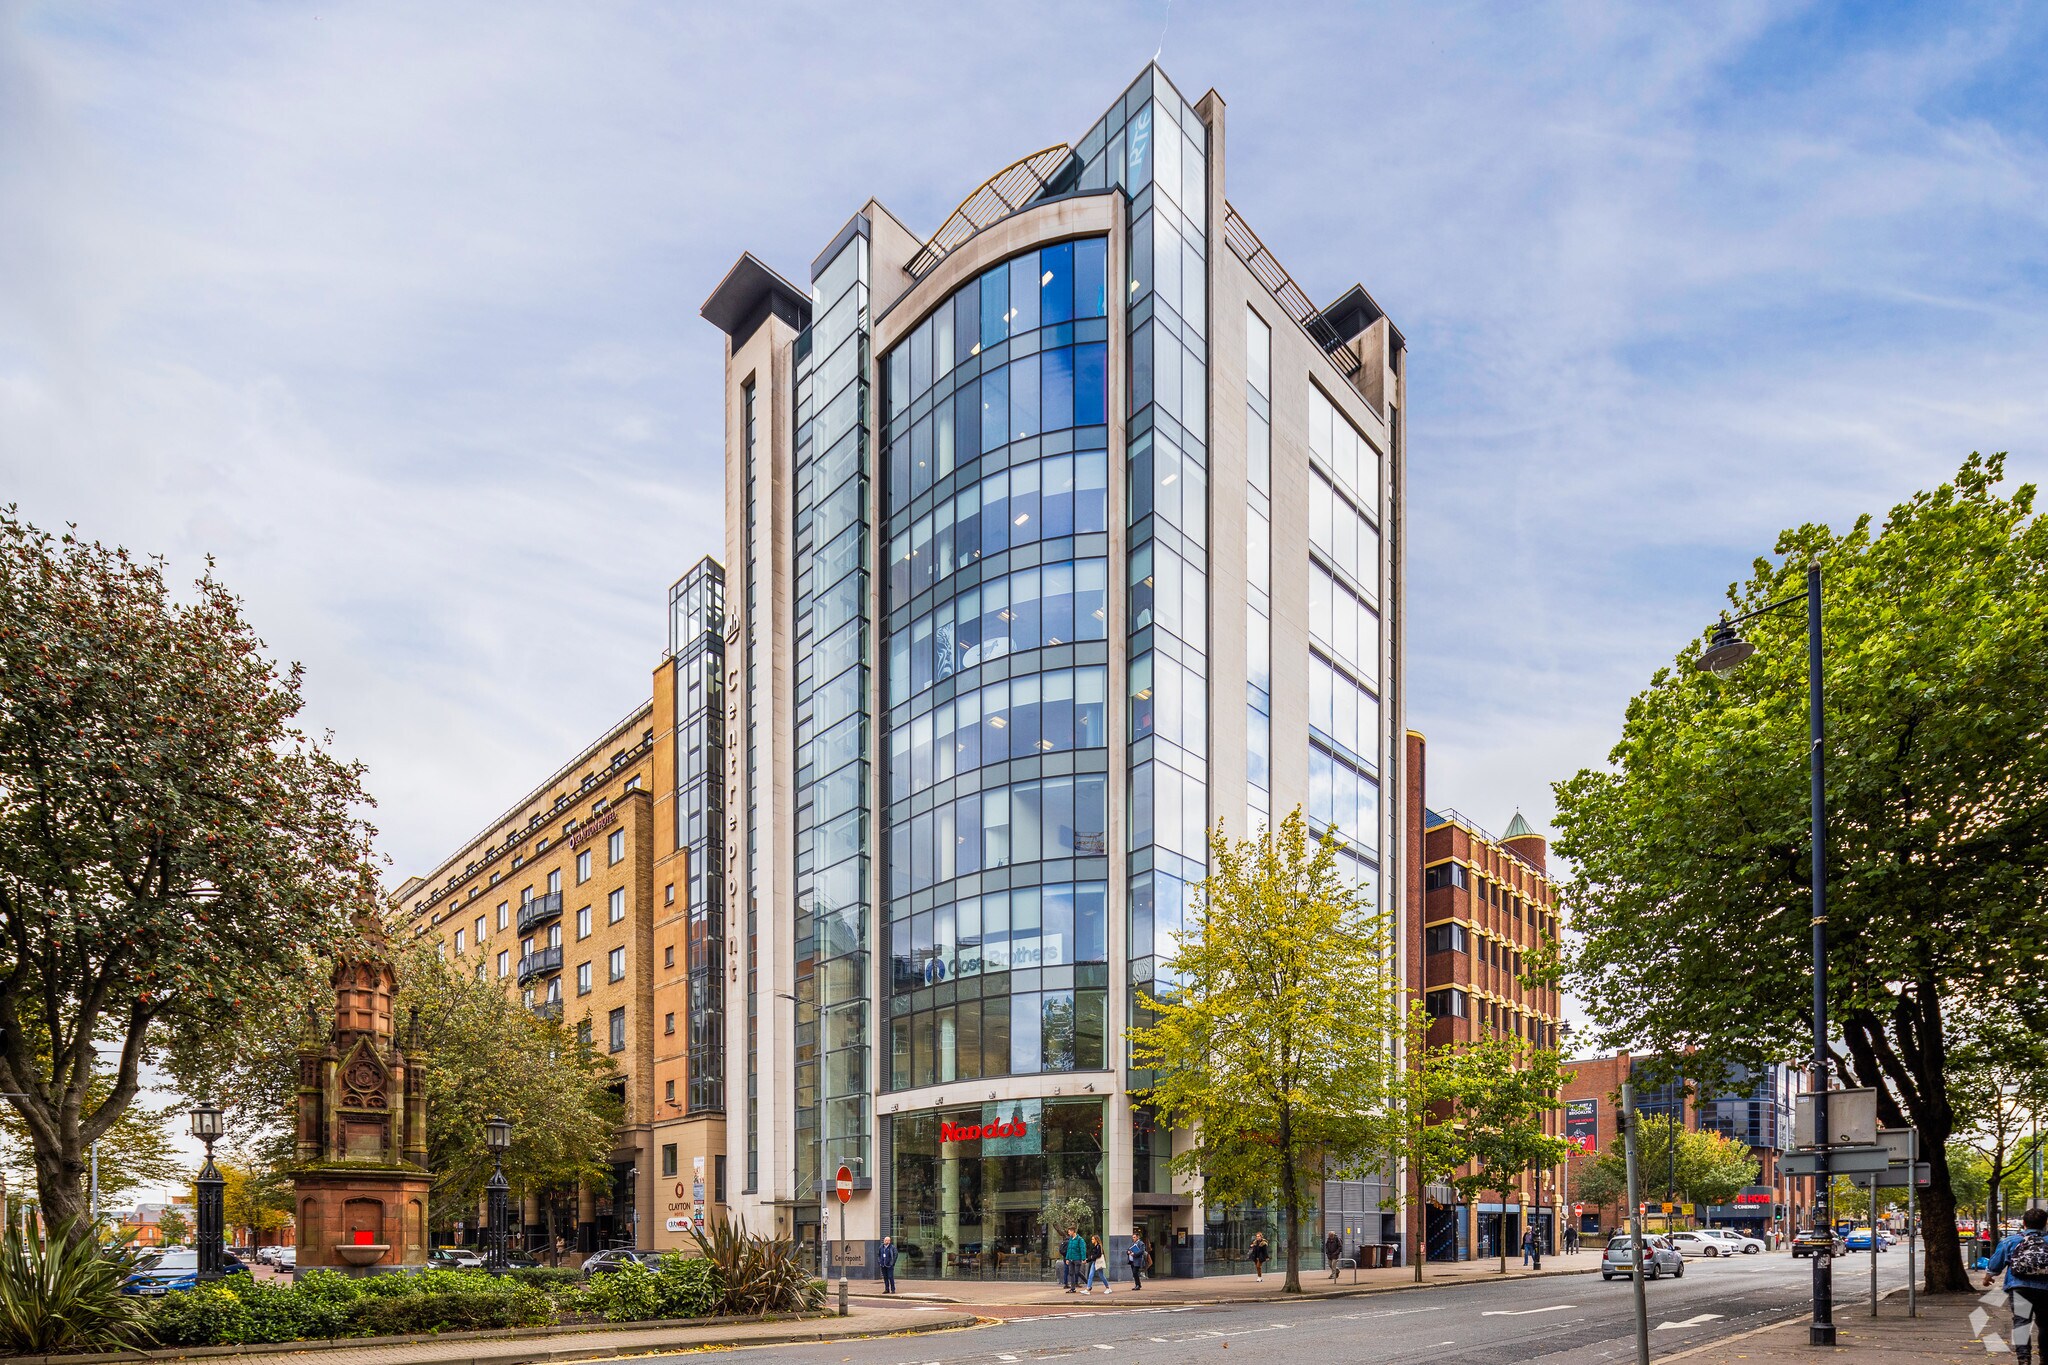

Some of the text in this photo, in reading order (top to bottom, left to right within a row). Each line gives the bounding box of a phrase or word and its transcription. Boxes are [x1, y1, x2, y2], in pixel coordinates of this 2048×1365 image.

[726, 668, 739, 983] Centrepoint
[948, 946, 1058, 976] Close Brothers
[938, 1116, 1027, 1143] Nando's
[668, 1202, 691, 1211] CLAYTON
[1747, 1193, 1771, 1204] HOUSE
[835, 1254, 862, 1265] Cerepoint
